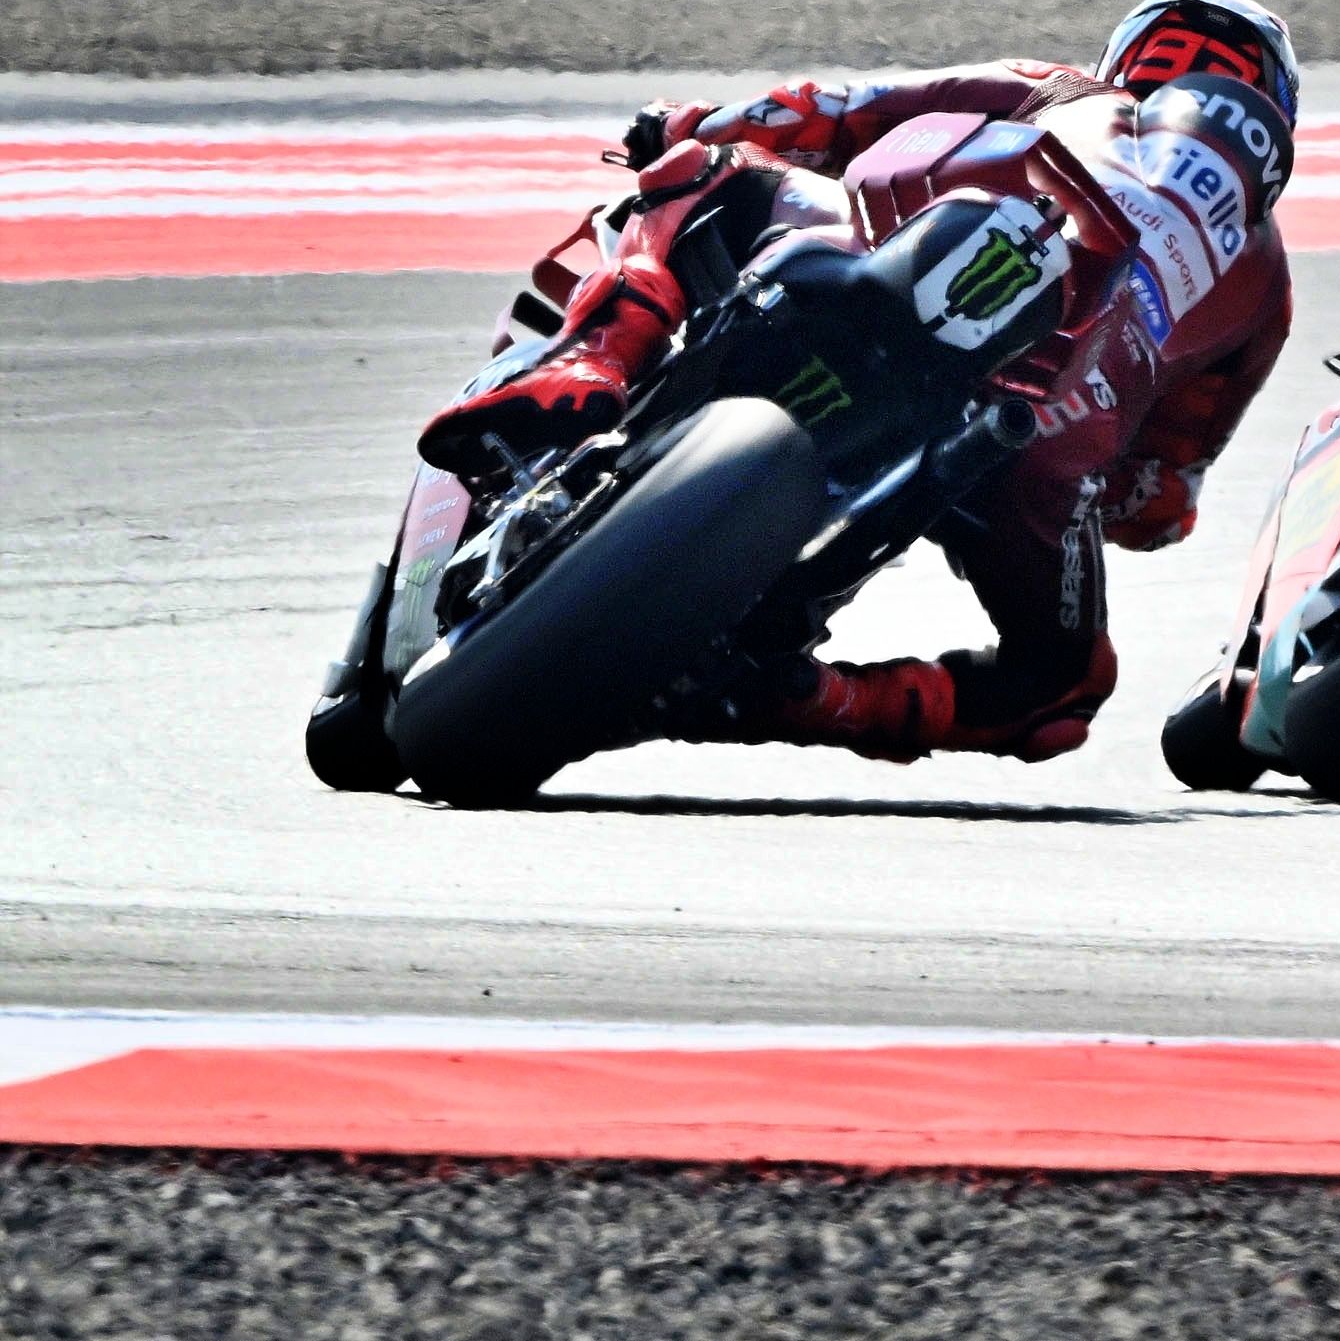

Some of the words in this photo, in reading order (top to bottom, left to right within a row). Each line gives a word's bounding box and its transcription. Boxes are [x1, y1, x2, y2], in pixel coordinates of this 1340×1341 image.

[1173, 145, 1241, 257] iello
[1188, 89, 1284, 219] novo
[1112, 191, 1164, 231] Audi
